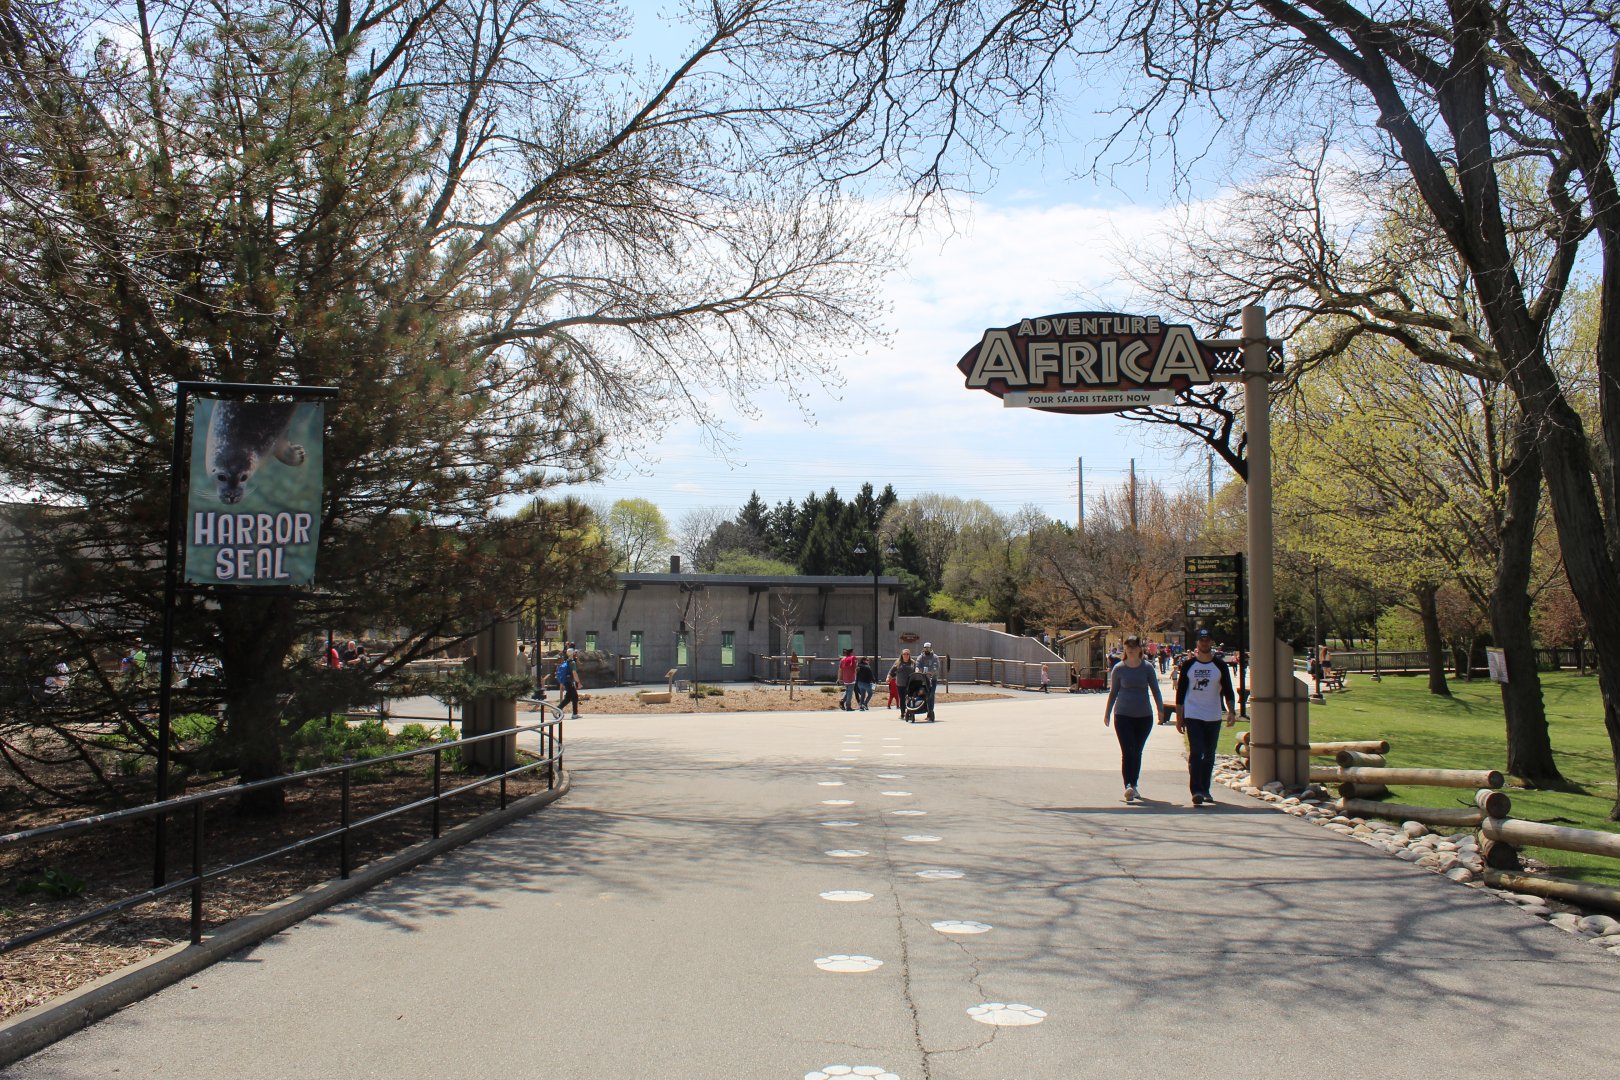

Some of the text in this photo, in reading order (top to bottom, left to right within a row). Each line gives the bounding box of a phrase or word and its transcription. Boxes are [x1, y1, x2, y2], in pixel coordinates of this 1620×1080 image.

[1017, 316, 1160, 336] ADVENTURE
[967, 326, 1211, 387] AFRICA
[1028, 394, 1151, 404] YOUR SAFARI STARTS NOW
[194, 512, 312, 545] HARBOR
[216, 547, 290, 580] SEAL
